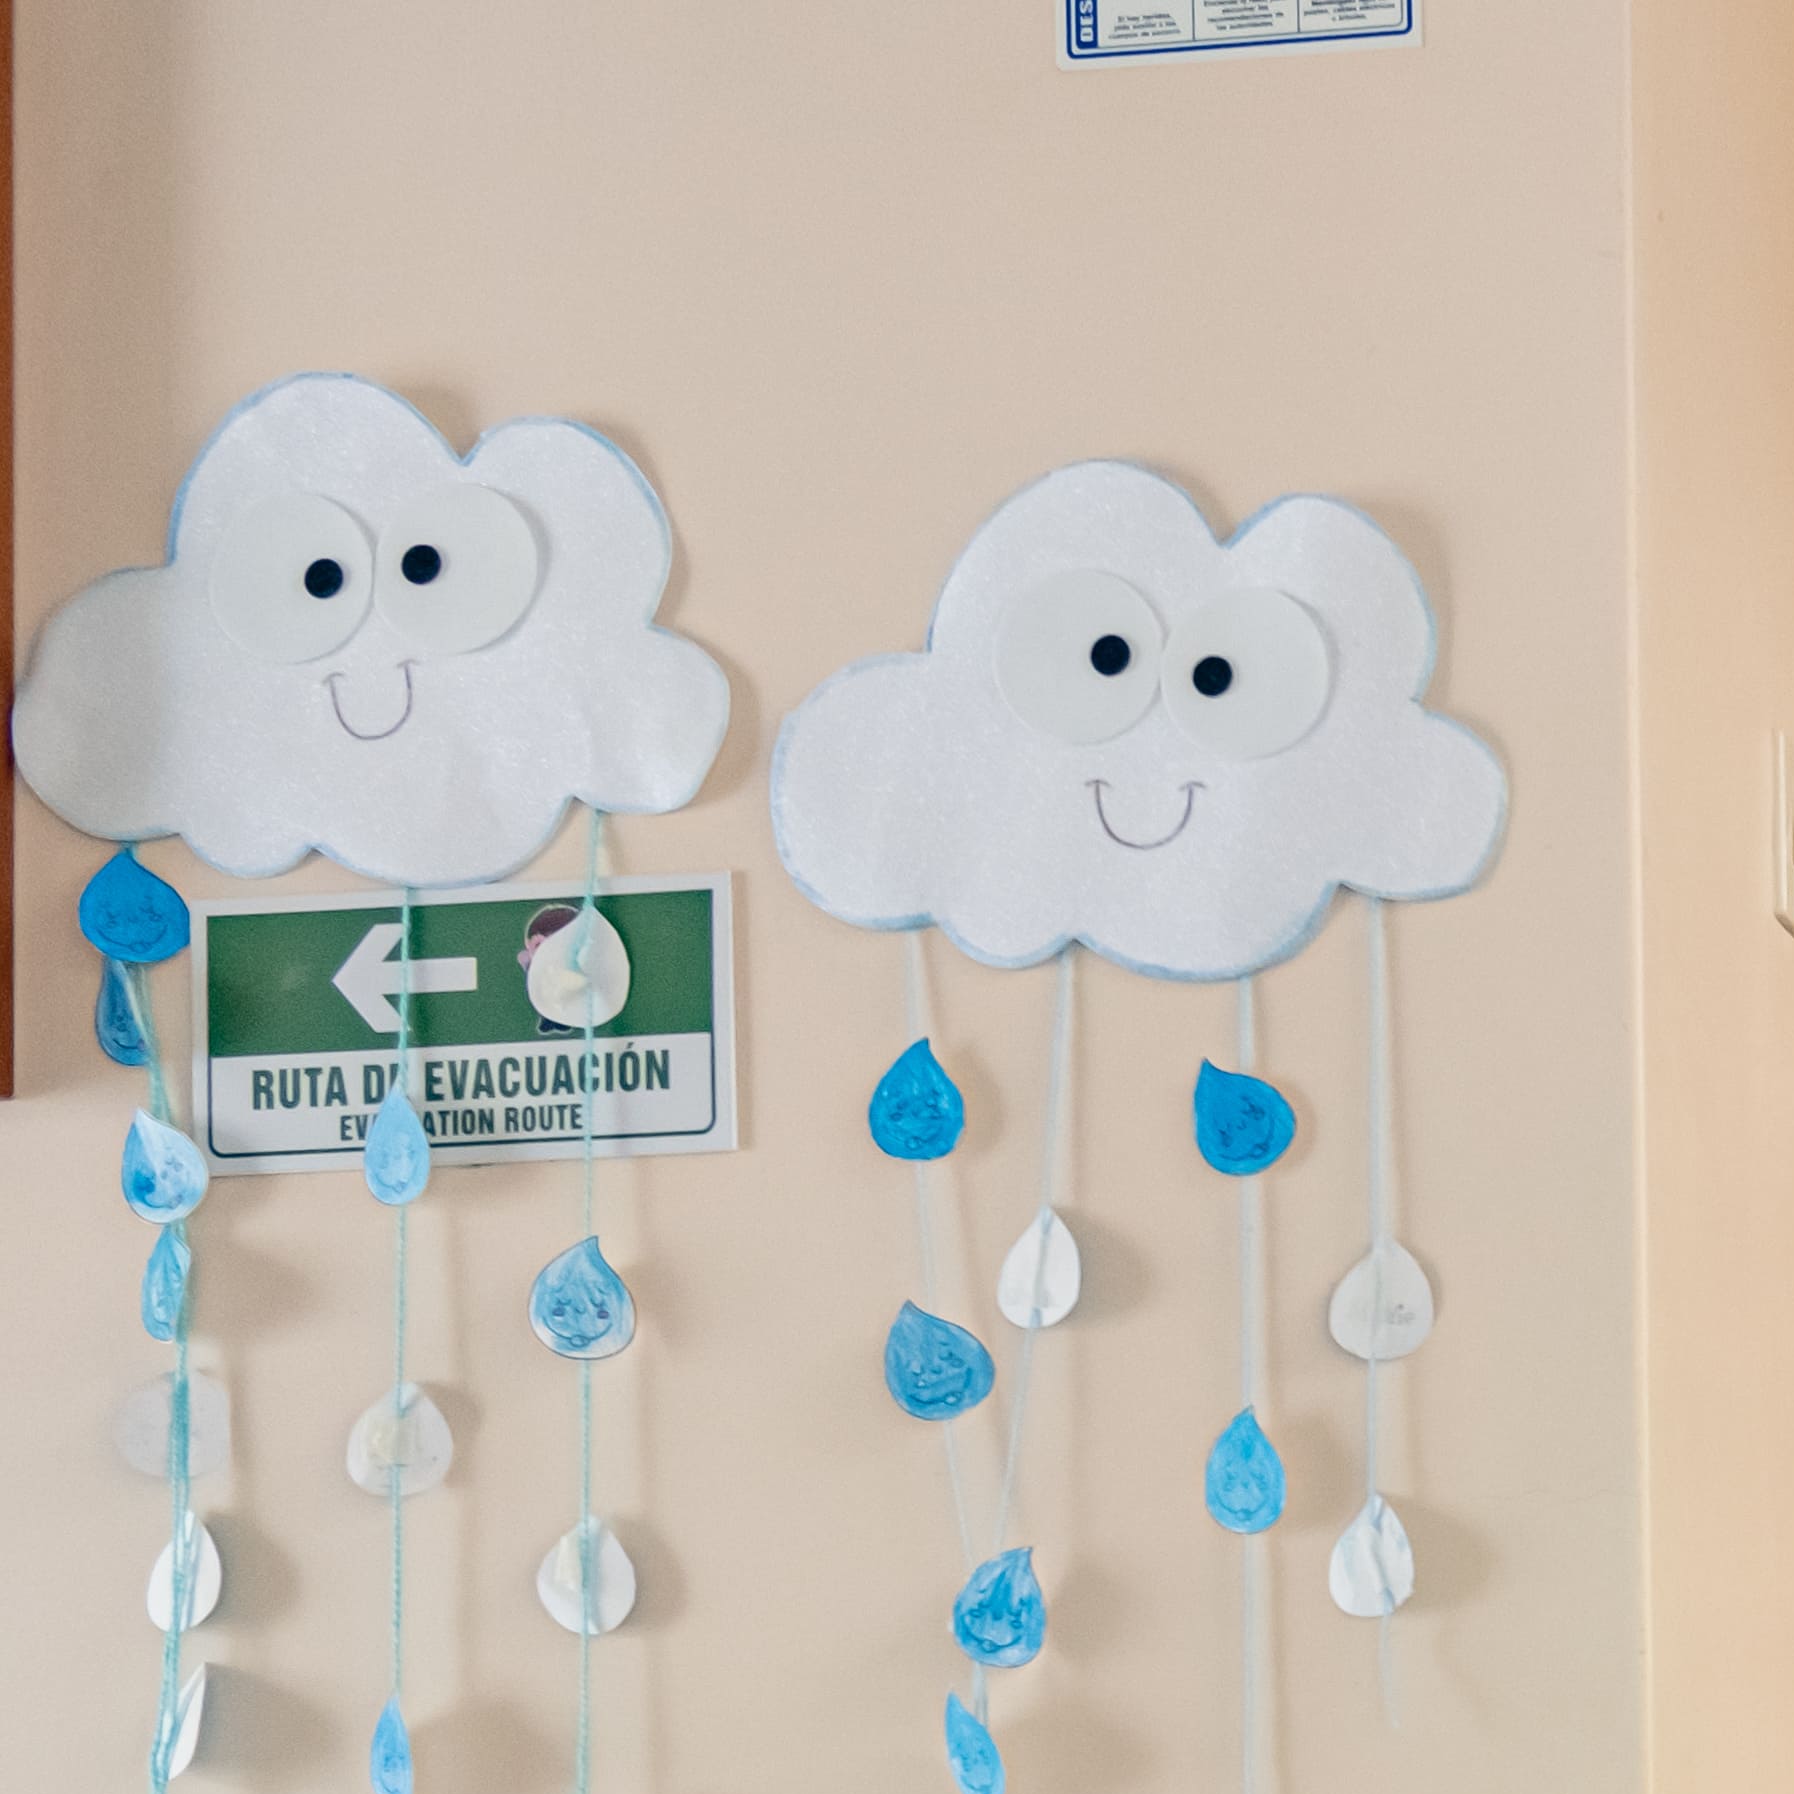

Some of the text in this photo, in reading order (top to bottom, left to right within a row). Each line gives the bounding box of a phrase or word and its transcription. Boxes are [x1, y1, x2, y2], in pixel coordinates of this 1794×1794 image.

[252, 1065, 348, 1110] RUTA
[425, 1042, 670, 1102] EVACUACIÓN
[340, 1103, 583, 1141] EVATION ROUTE
